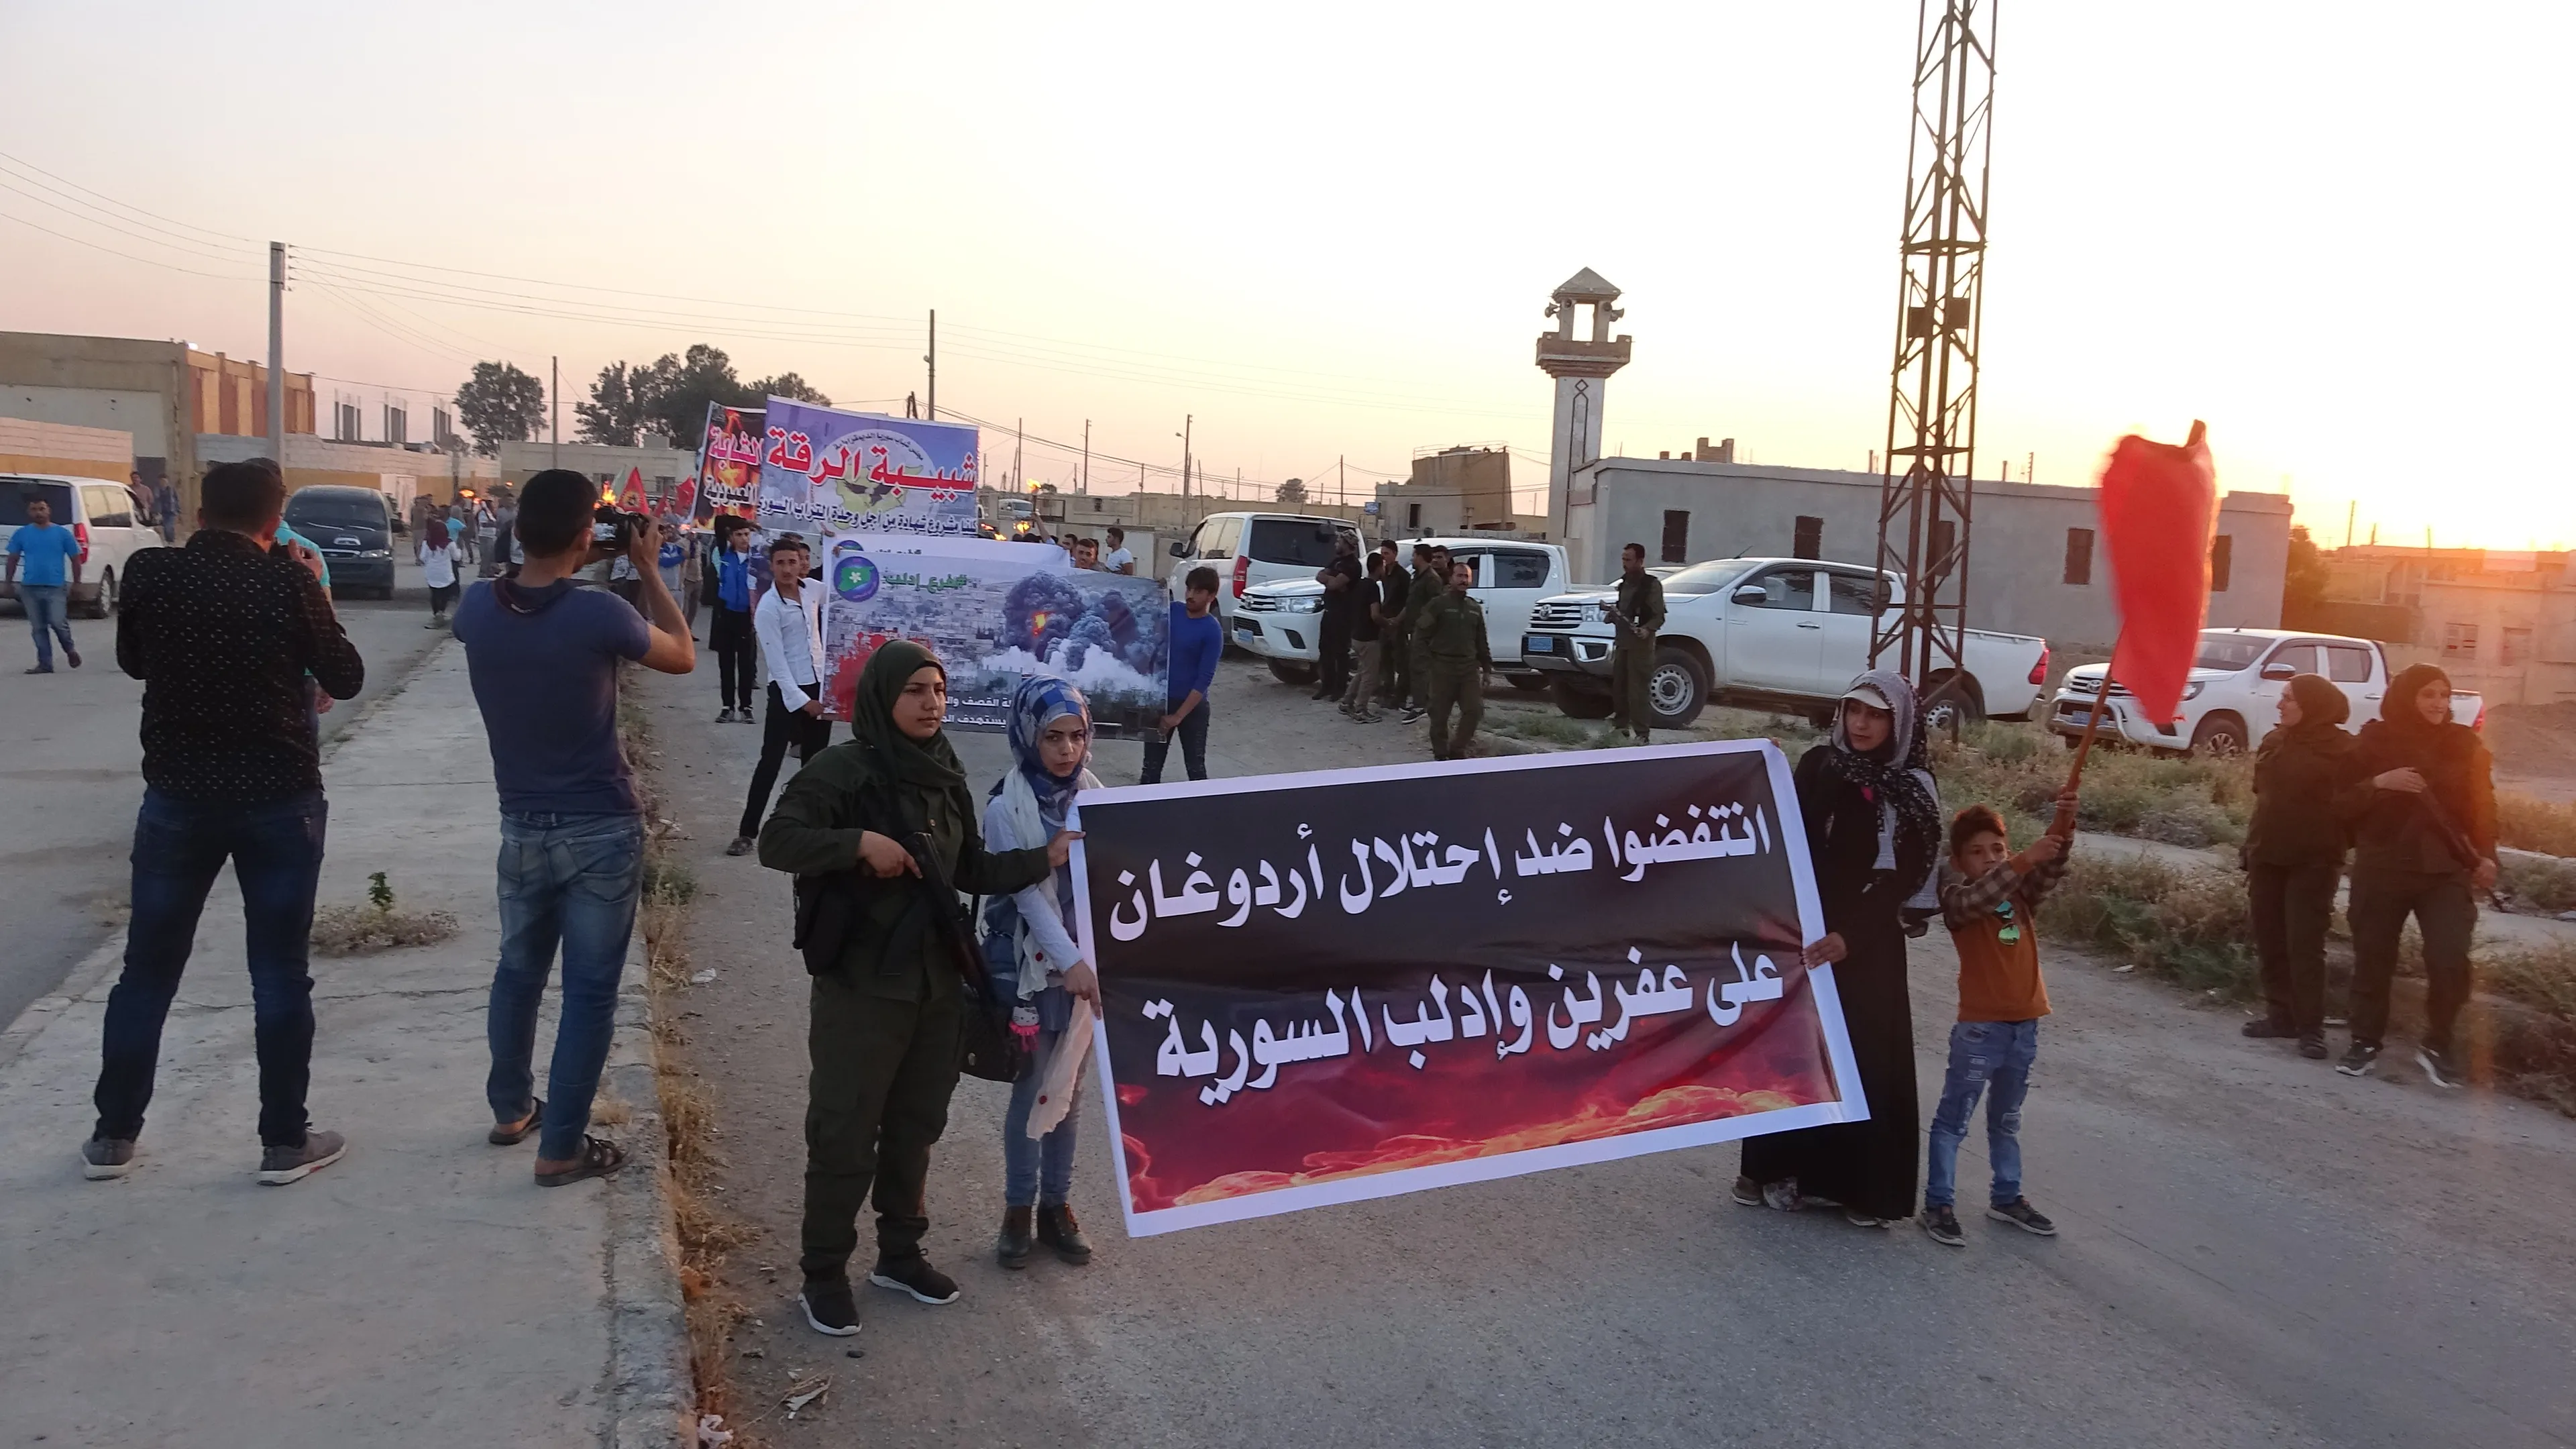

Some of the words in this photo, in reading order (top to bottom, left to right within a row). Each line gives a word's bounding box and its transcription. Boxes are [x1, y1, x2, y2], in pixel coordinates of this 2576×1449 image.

[767, 425, 863, 486] الرقة
[869, 444, 976, 502] شبيبة
[794, 502, 830, 522] التراب
[832, 504, 859, 528] وحدة
[861, 509, 881, 529] أجل
[883, 514, 896, 532] من
[898, 514, 926, 535] شهادة
[927, 515, 959, 537] مشروع
[957, 714, 1006, 728] يستهدف
[961, 696, 1000, 707] القصف
[1515, 822, 1593, 877] ضد
[1603, 801, 1771, 881] انتفضوا
[1110, 822, 1325, 941] أردوغان
[1340, 826, 1513, 914] إحتلال
[1547, 946, 1693, 1051] عفرين
[1707, 941, 1784, 1026] على
[1142, 985, 1372, 1106] السورية
[1383, 969, 1533, 1069] وإدلب
